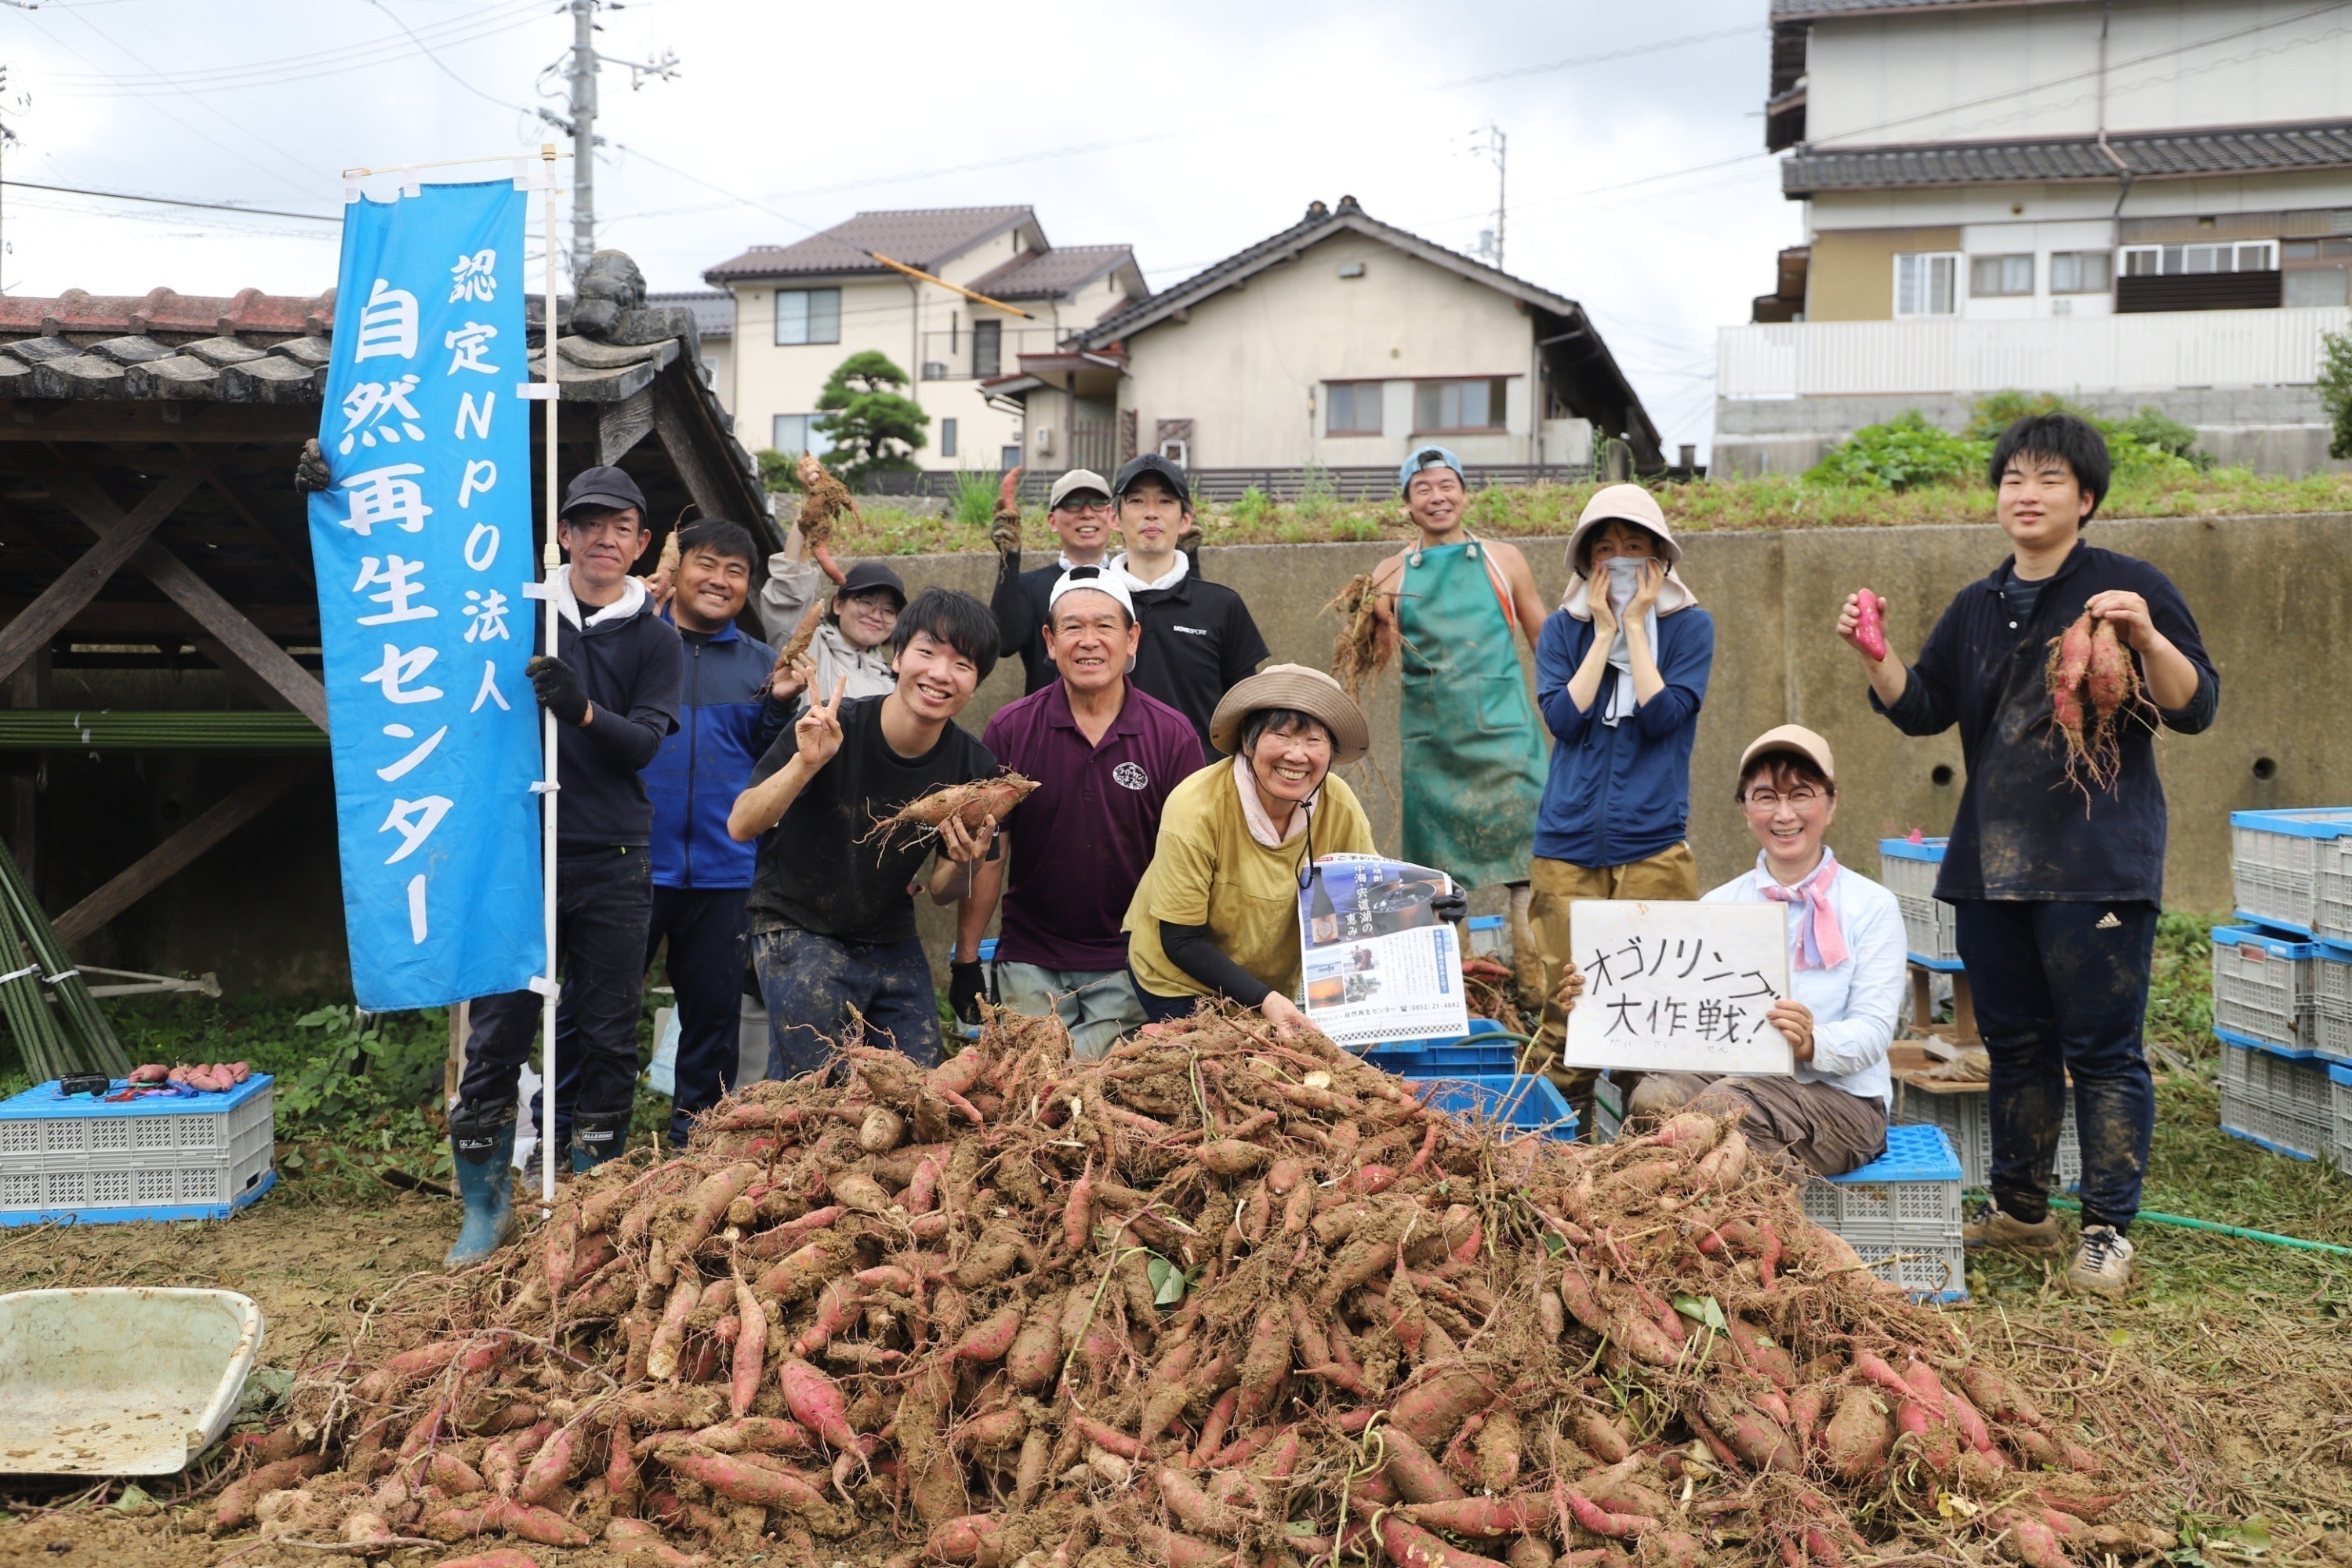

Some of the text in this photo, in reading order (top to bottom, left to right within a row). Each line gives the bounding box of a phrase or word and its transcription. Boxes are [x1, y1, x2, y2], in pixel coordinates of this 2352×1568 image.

[444, 249, 511, 713] 認定NPO法人
[339, 278, 455, 945] 自然再生センター
[1345, 1006, 1396, 1018] 自然再生センター
[1602, 992, 1766, 1045] 大作戦!
